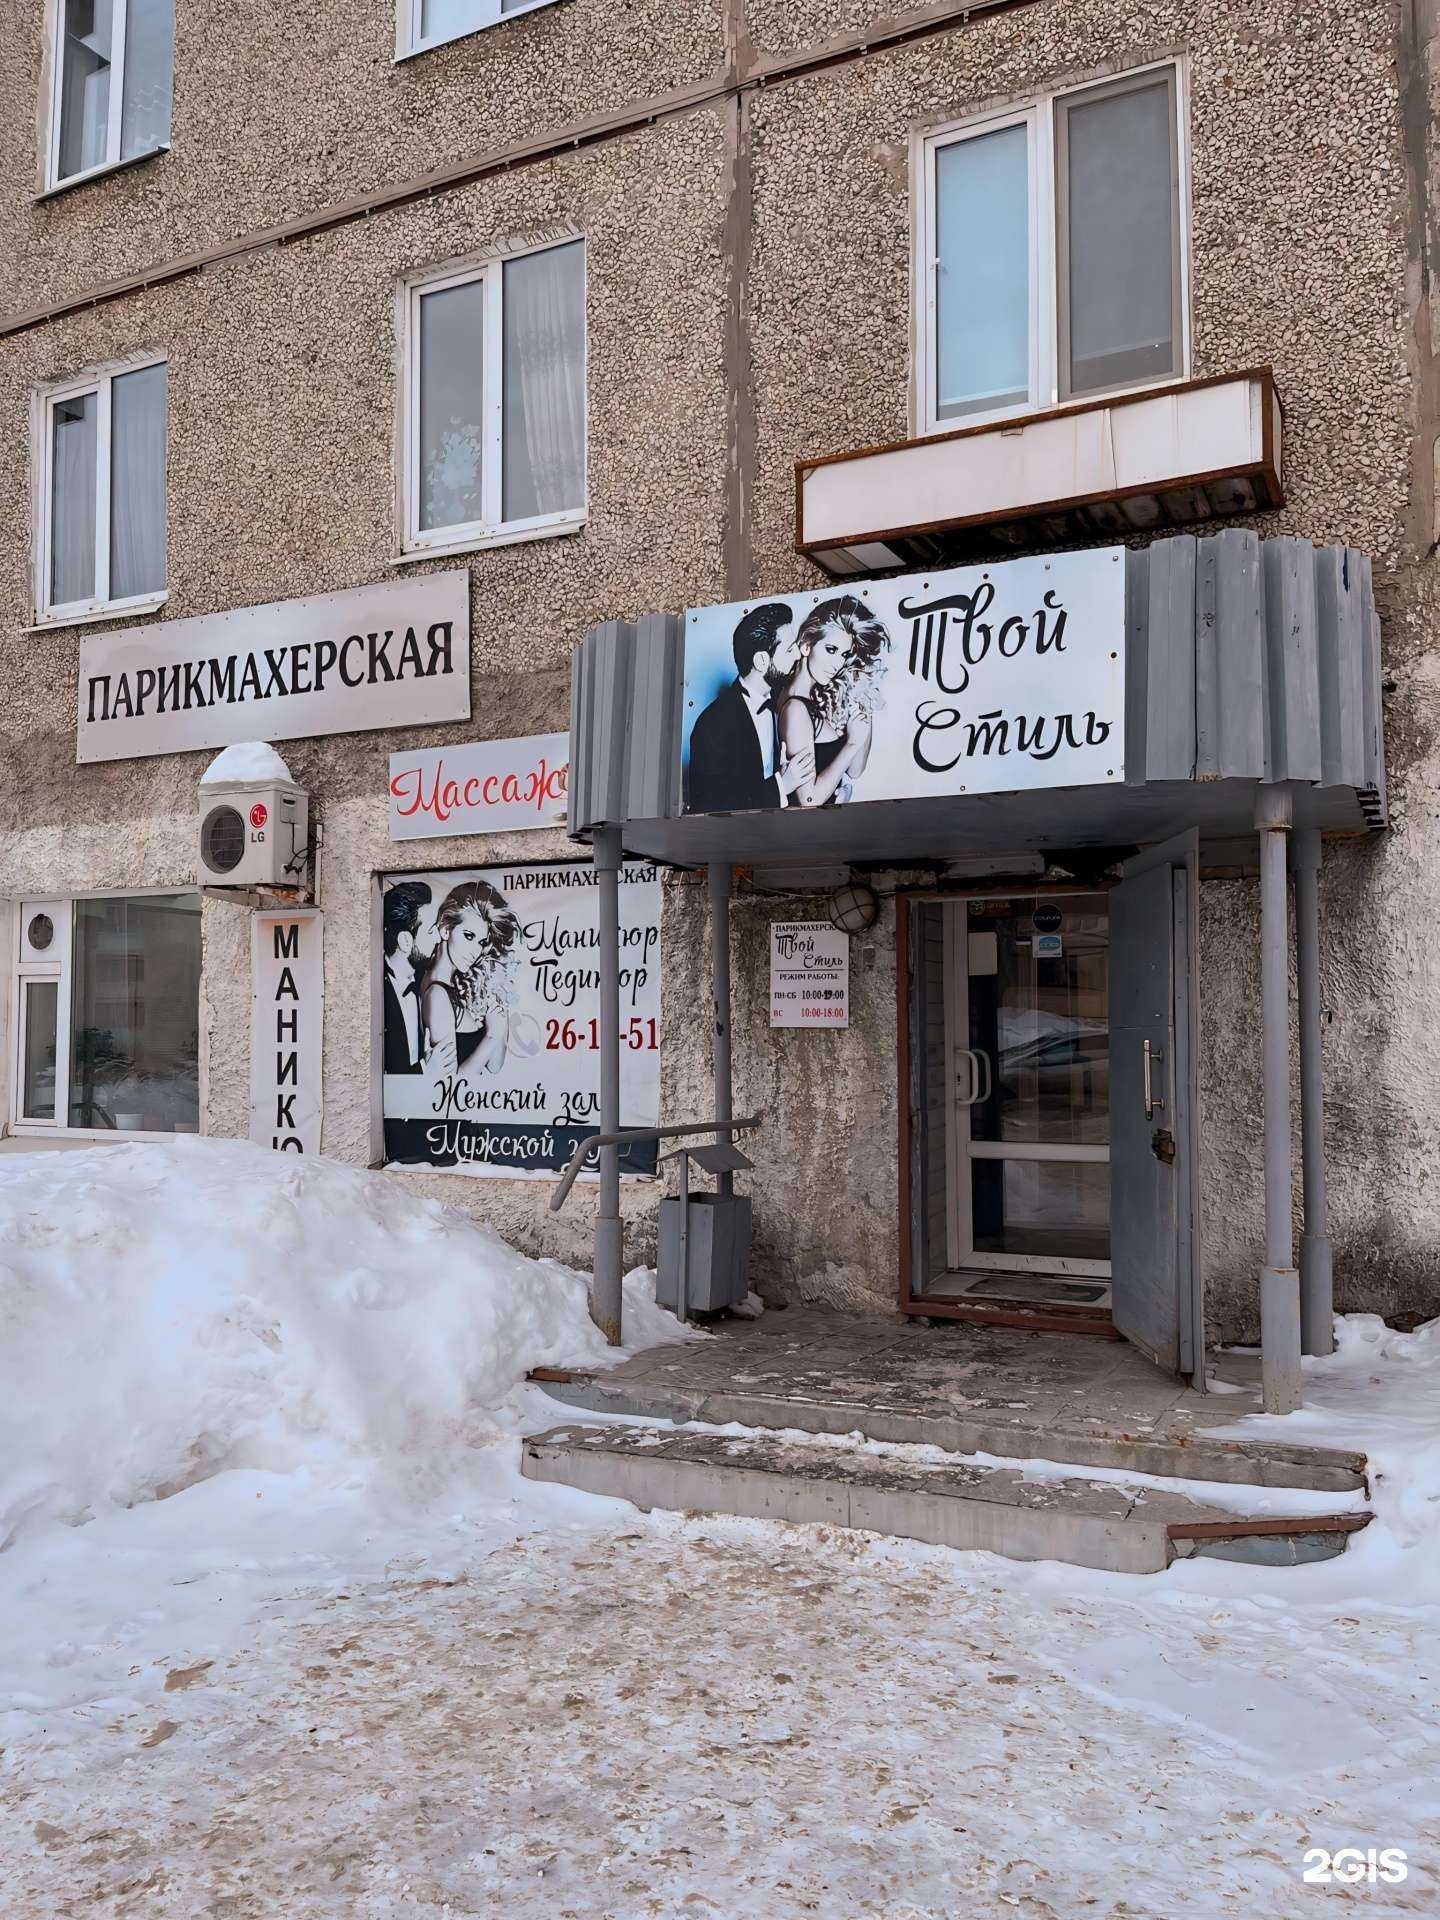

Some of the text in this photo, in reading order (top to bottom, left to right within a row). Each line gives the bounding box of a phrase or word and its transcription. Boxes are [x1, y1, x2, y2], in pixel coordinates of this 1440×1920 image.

[898, 583, 1067, 694] Твой
[86, 621, 454, 722] ПАРИКМАХЕРСКАЯ
[912, 700, 1113, 773] Стиль
[390, 758, 562, 821] Массаж
[251, 832, 265, 843] LG
[503, 866, 657, 891] ПАРИКМАХЕСКАЯ
[523, 915, 658, 964] Маниюр
[775, 932, 815, 960] Твой
[776, 923, 837, 932] ПАРИКМАХЕРСК
[779, 973, 806, 981] РЕЖИМ
[803, 953, 843, 969] Стиль
[801, 1007, 844, 1018] 10:00-18:00
[272, 924, 304, 1154] МАНИК
[546, 1017, 659, 1051] 26-1-51
[432, 1075, 547, 1118] Женский
[426, 1120, 555, 1162] Мужской
